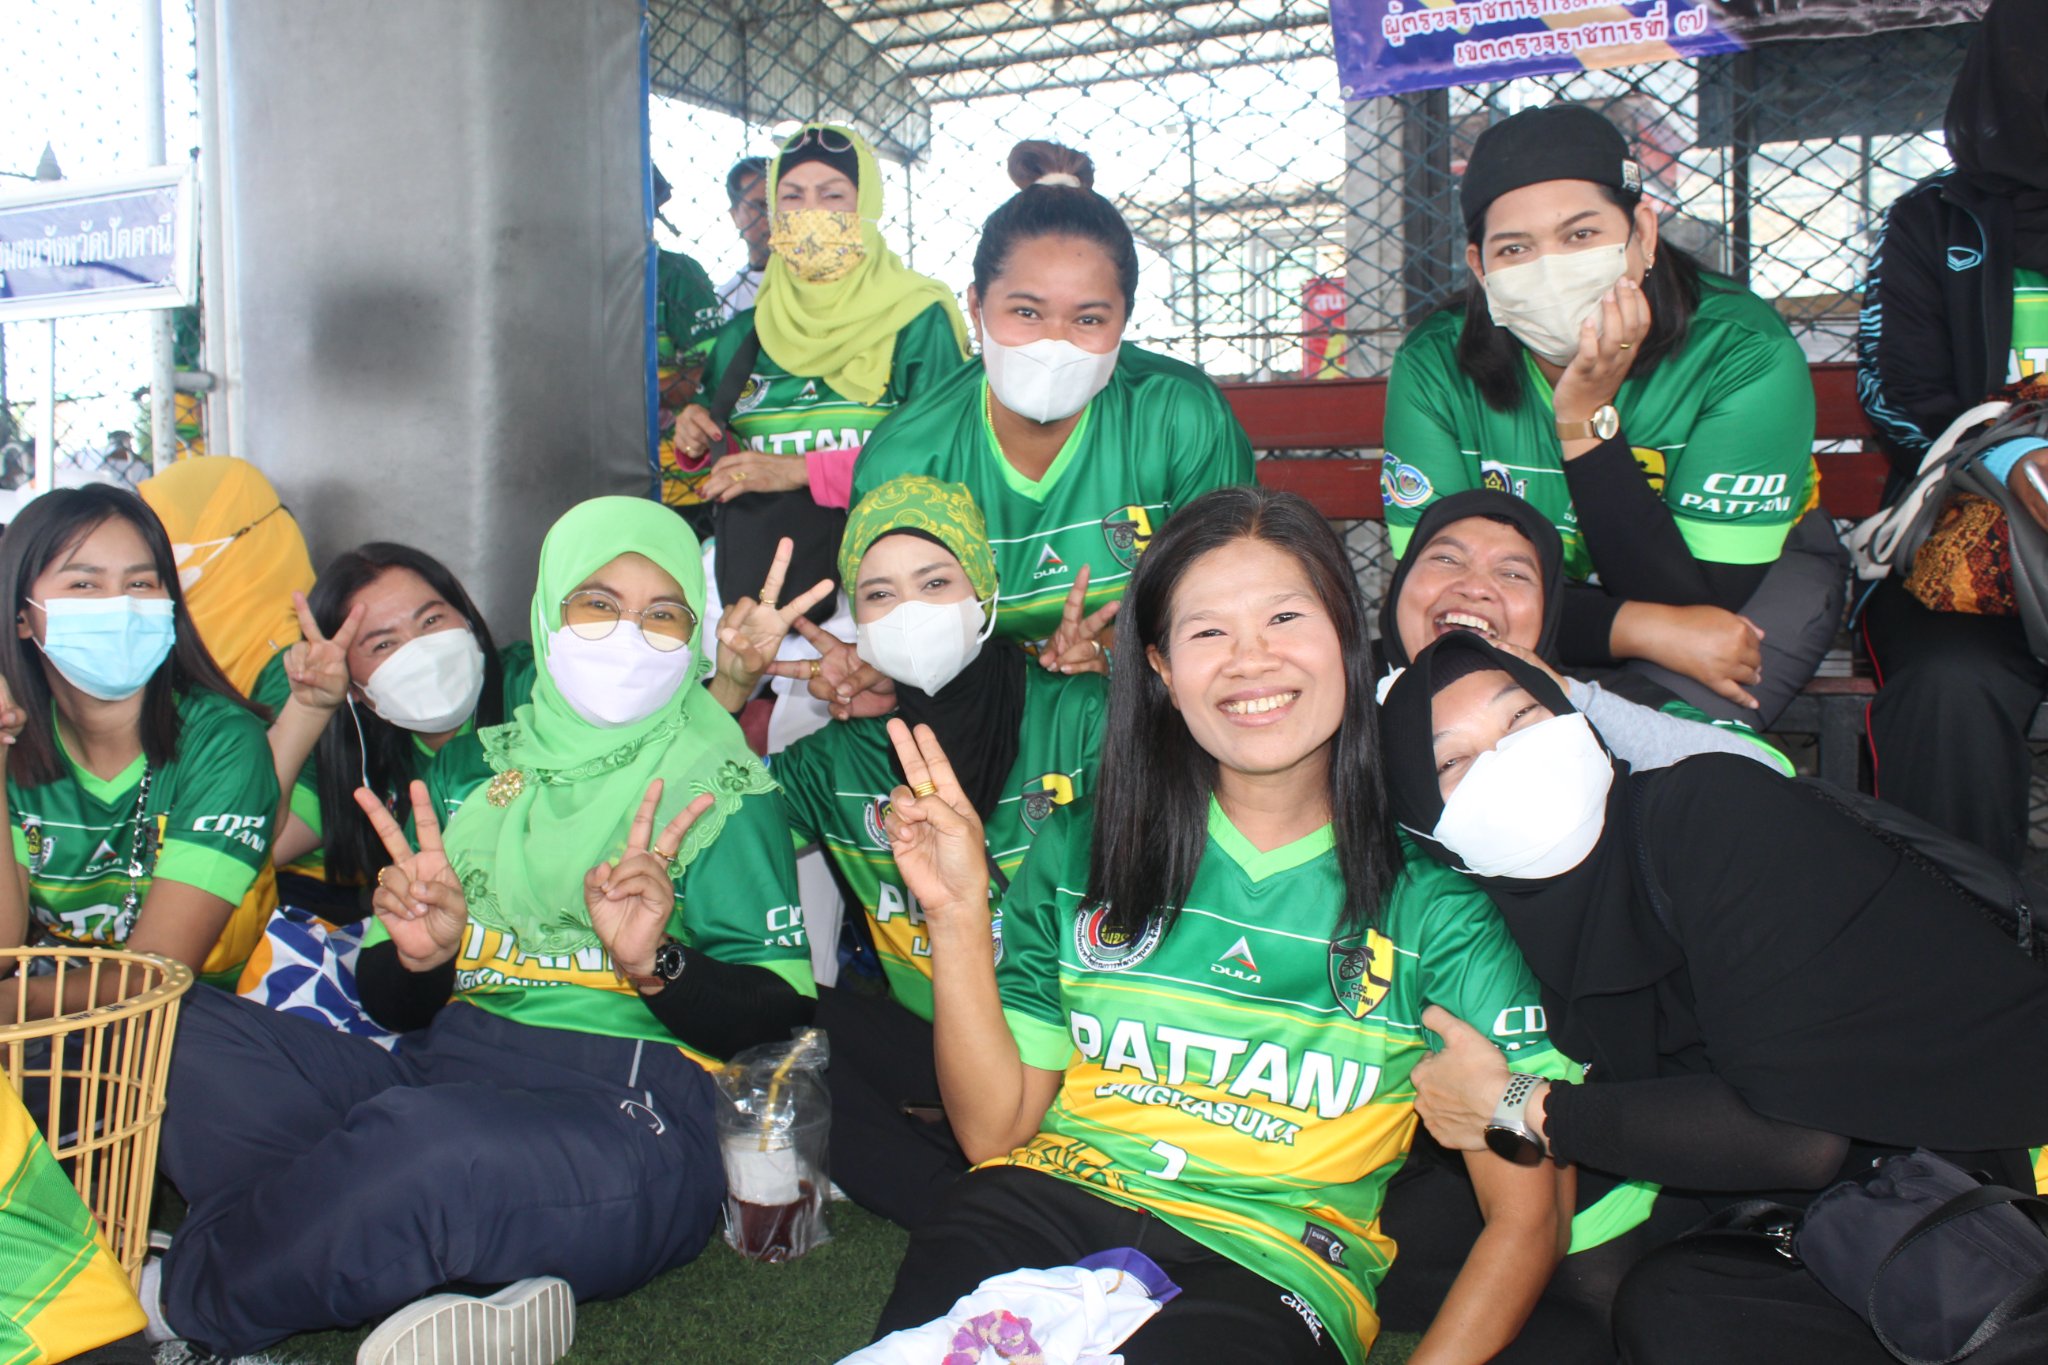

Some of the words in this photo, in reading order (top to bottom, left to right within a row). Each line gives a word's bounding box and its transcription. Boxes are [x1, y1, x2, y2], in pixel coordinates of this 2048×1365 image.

[1456, 3, 1665, 64] เขตตรวจราชการที่
[1677, 8, 1705, 33] ๗
[0, 213, 173, 272] มชนจังหวัดปัตตานี
[1680, 493, 1791, 514] PATTANI
[1703, 473, 1787, 496] CDD
[1210, 963, 1262, 984] DULA
[1070, 1010, 1382, 1119] PATTANI
